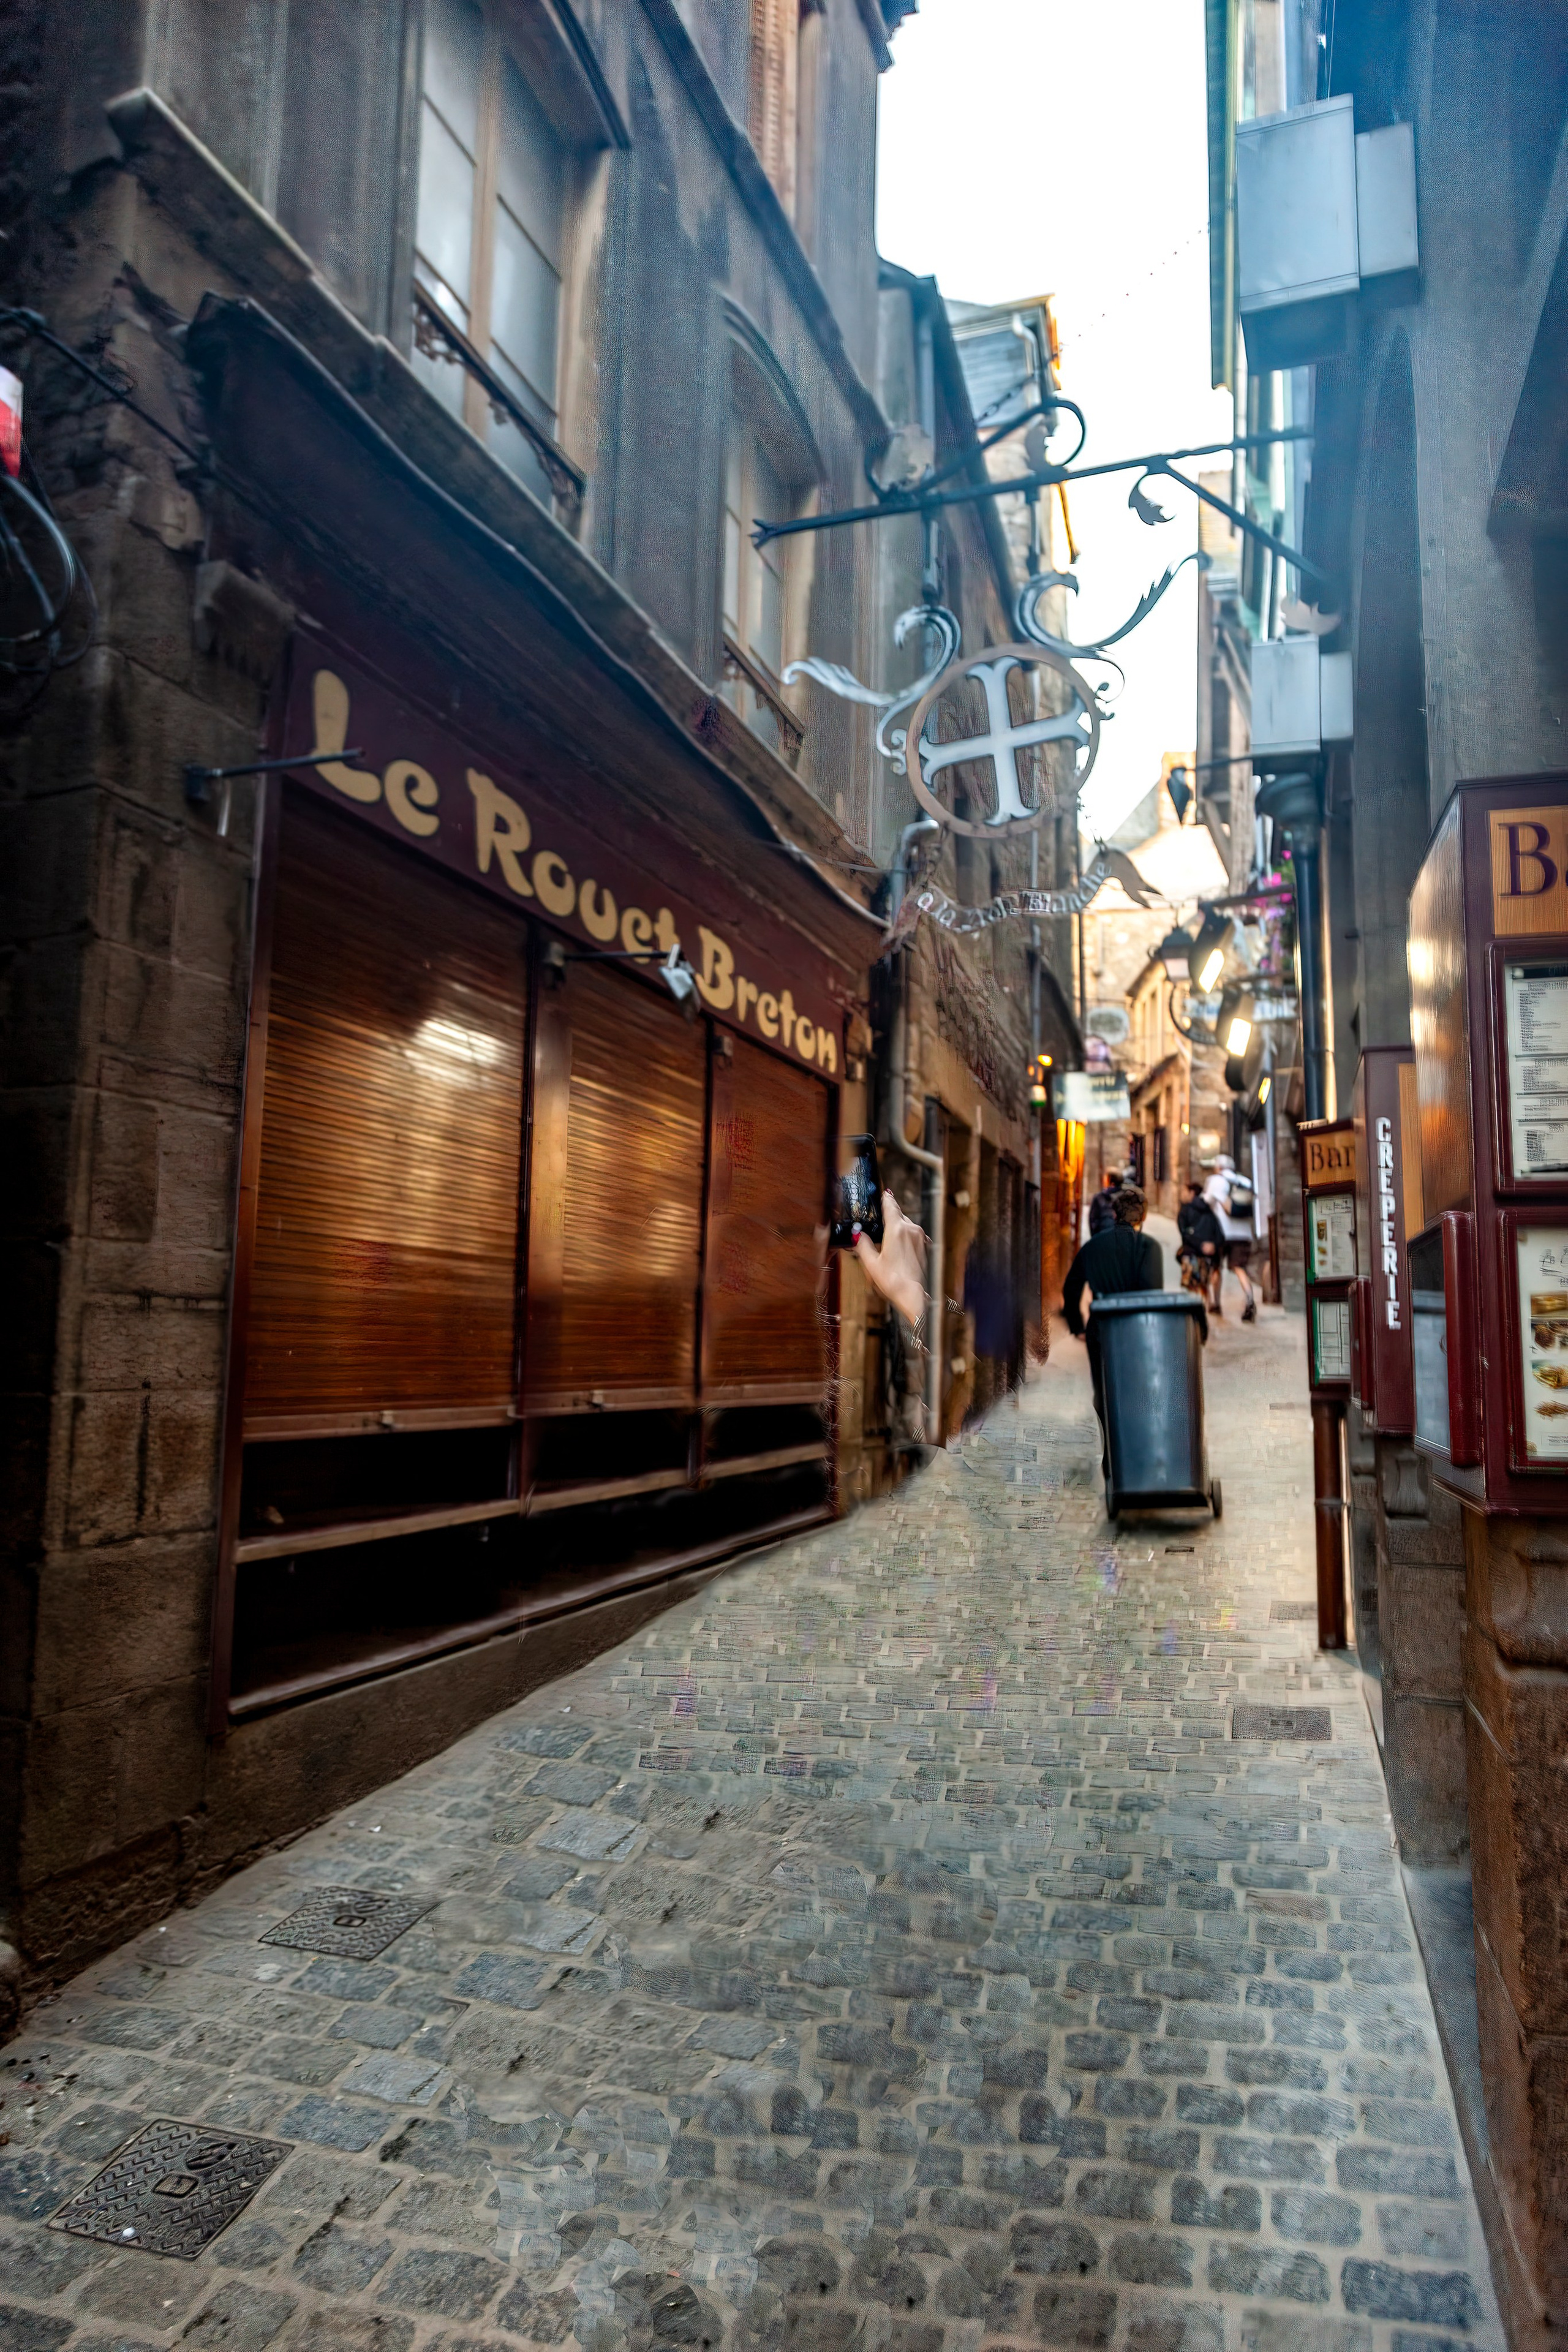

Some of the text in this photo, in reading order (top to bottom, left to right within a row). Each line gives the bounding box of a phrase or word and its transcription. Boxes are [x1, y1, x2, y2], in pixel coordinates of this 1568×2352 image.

[312, 669, 838, 1074] Le Rouet Breton
[1498, 821, 1568, 897] B
[1310, 1142, 1356, 1172] Bar
[1375, 1116, 1401, 1330] CREPERIE
